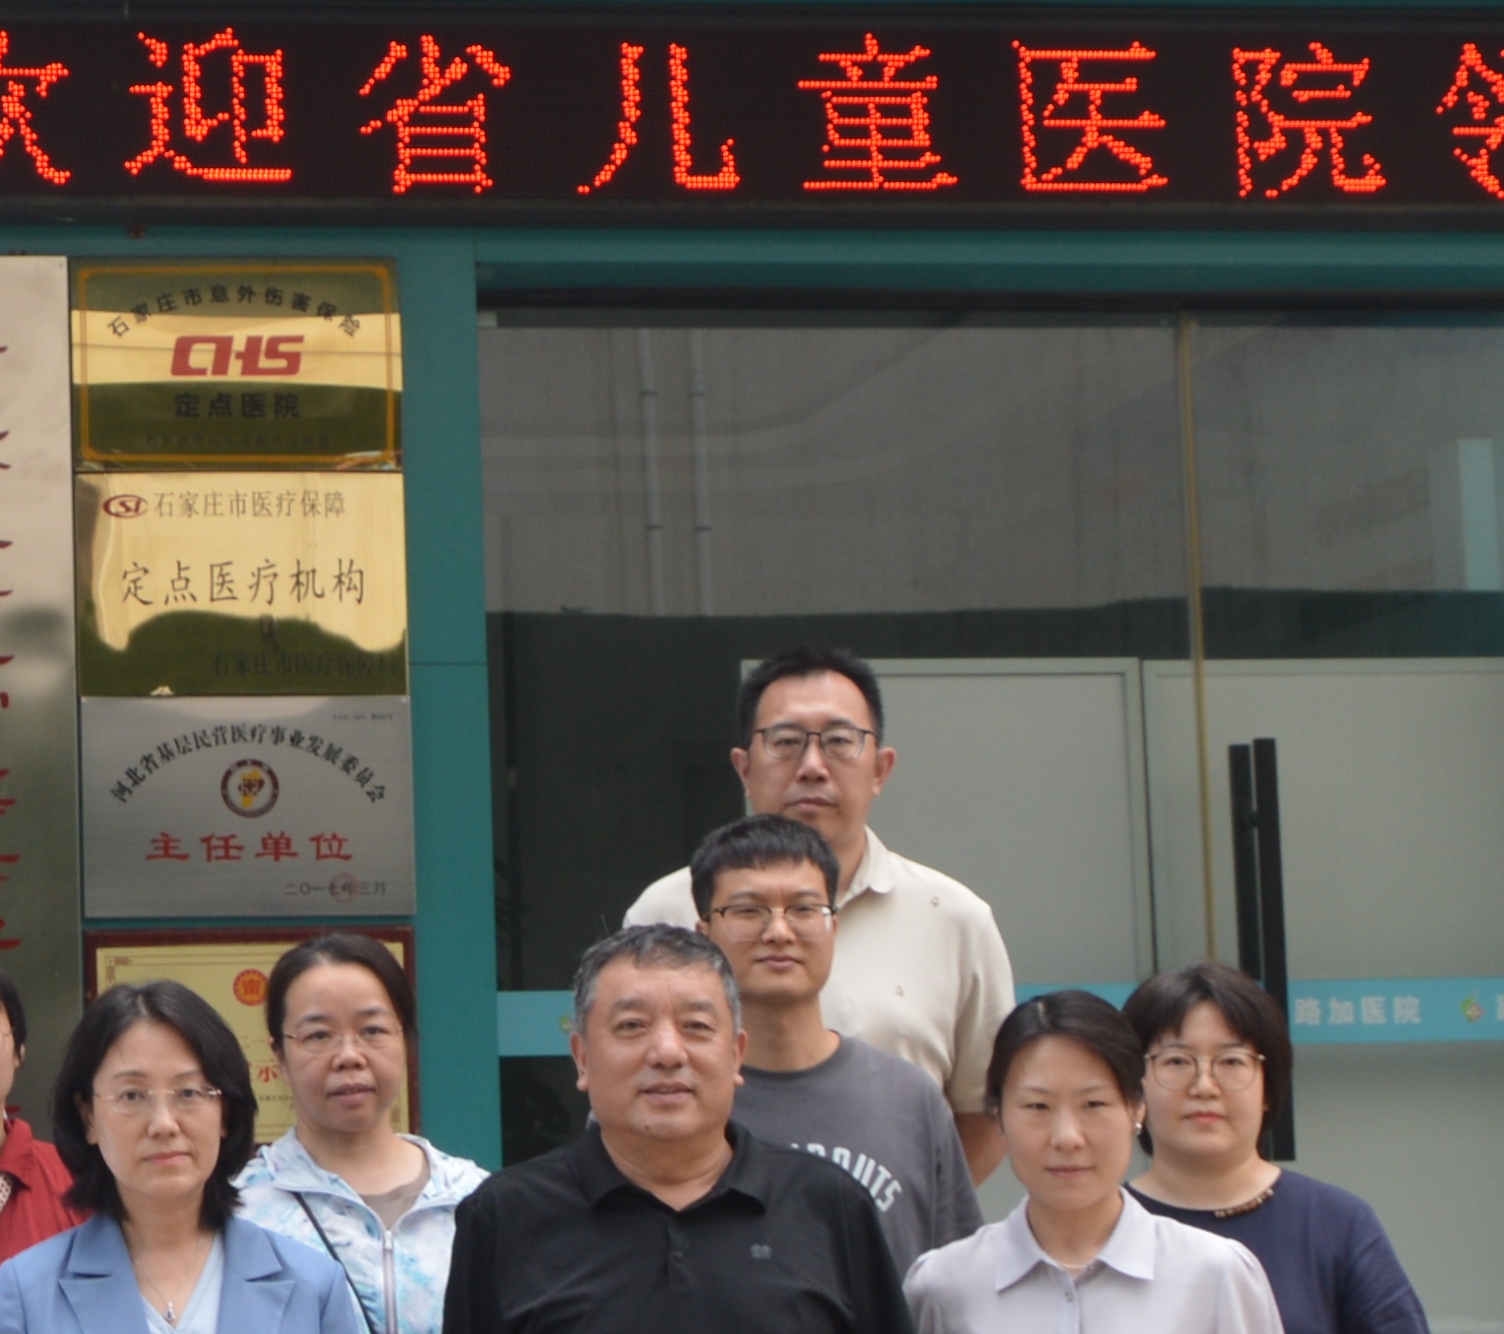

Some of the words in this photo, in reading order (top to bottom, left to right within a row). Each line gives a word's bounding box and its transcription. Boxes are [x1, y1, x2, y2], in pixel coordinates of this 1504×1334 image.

[107, 283, 362, 339] 石家庄市意外伤害保险
[174, 392, 300, 419] 定点医院
[153, 490, 346, 519] 石家庄市医疗保障
[121, 558, 366, 605] 定点医疗机构
[109, 723, 387, 804] 河北省基层民营医疗事业发展委员会
[145, 831, 354, 863] 主任单位
[1294, 996, 1422, 1026] 路加医院
[791, 1142, 903, 1212] OUTS
